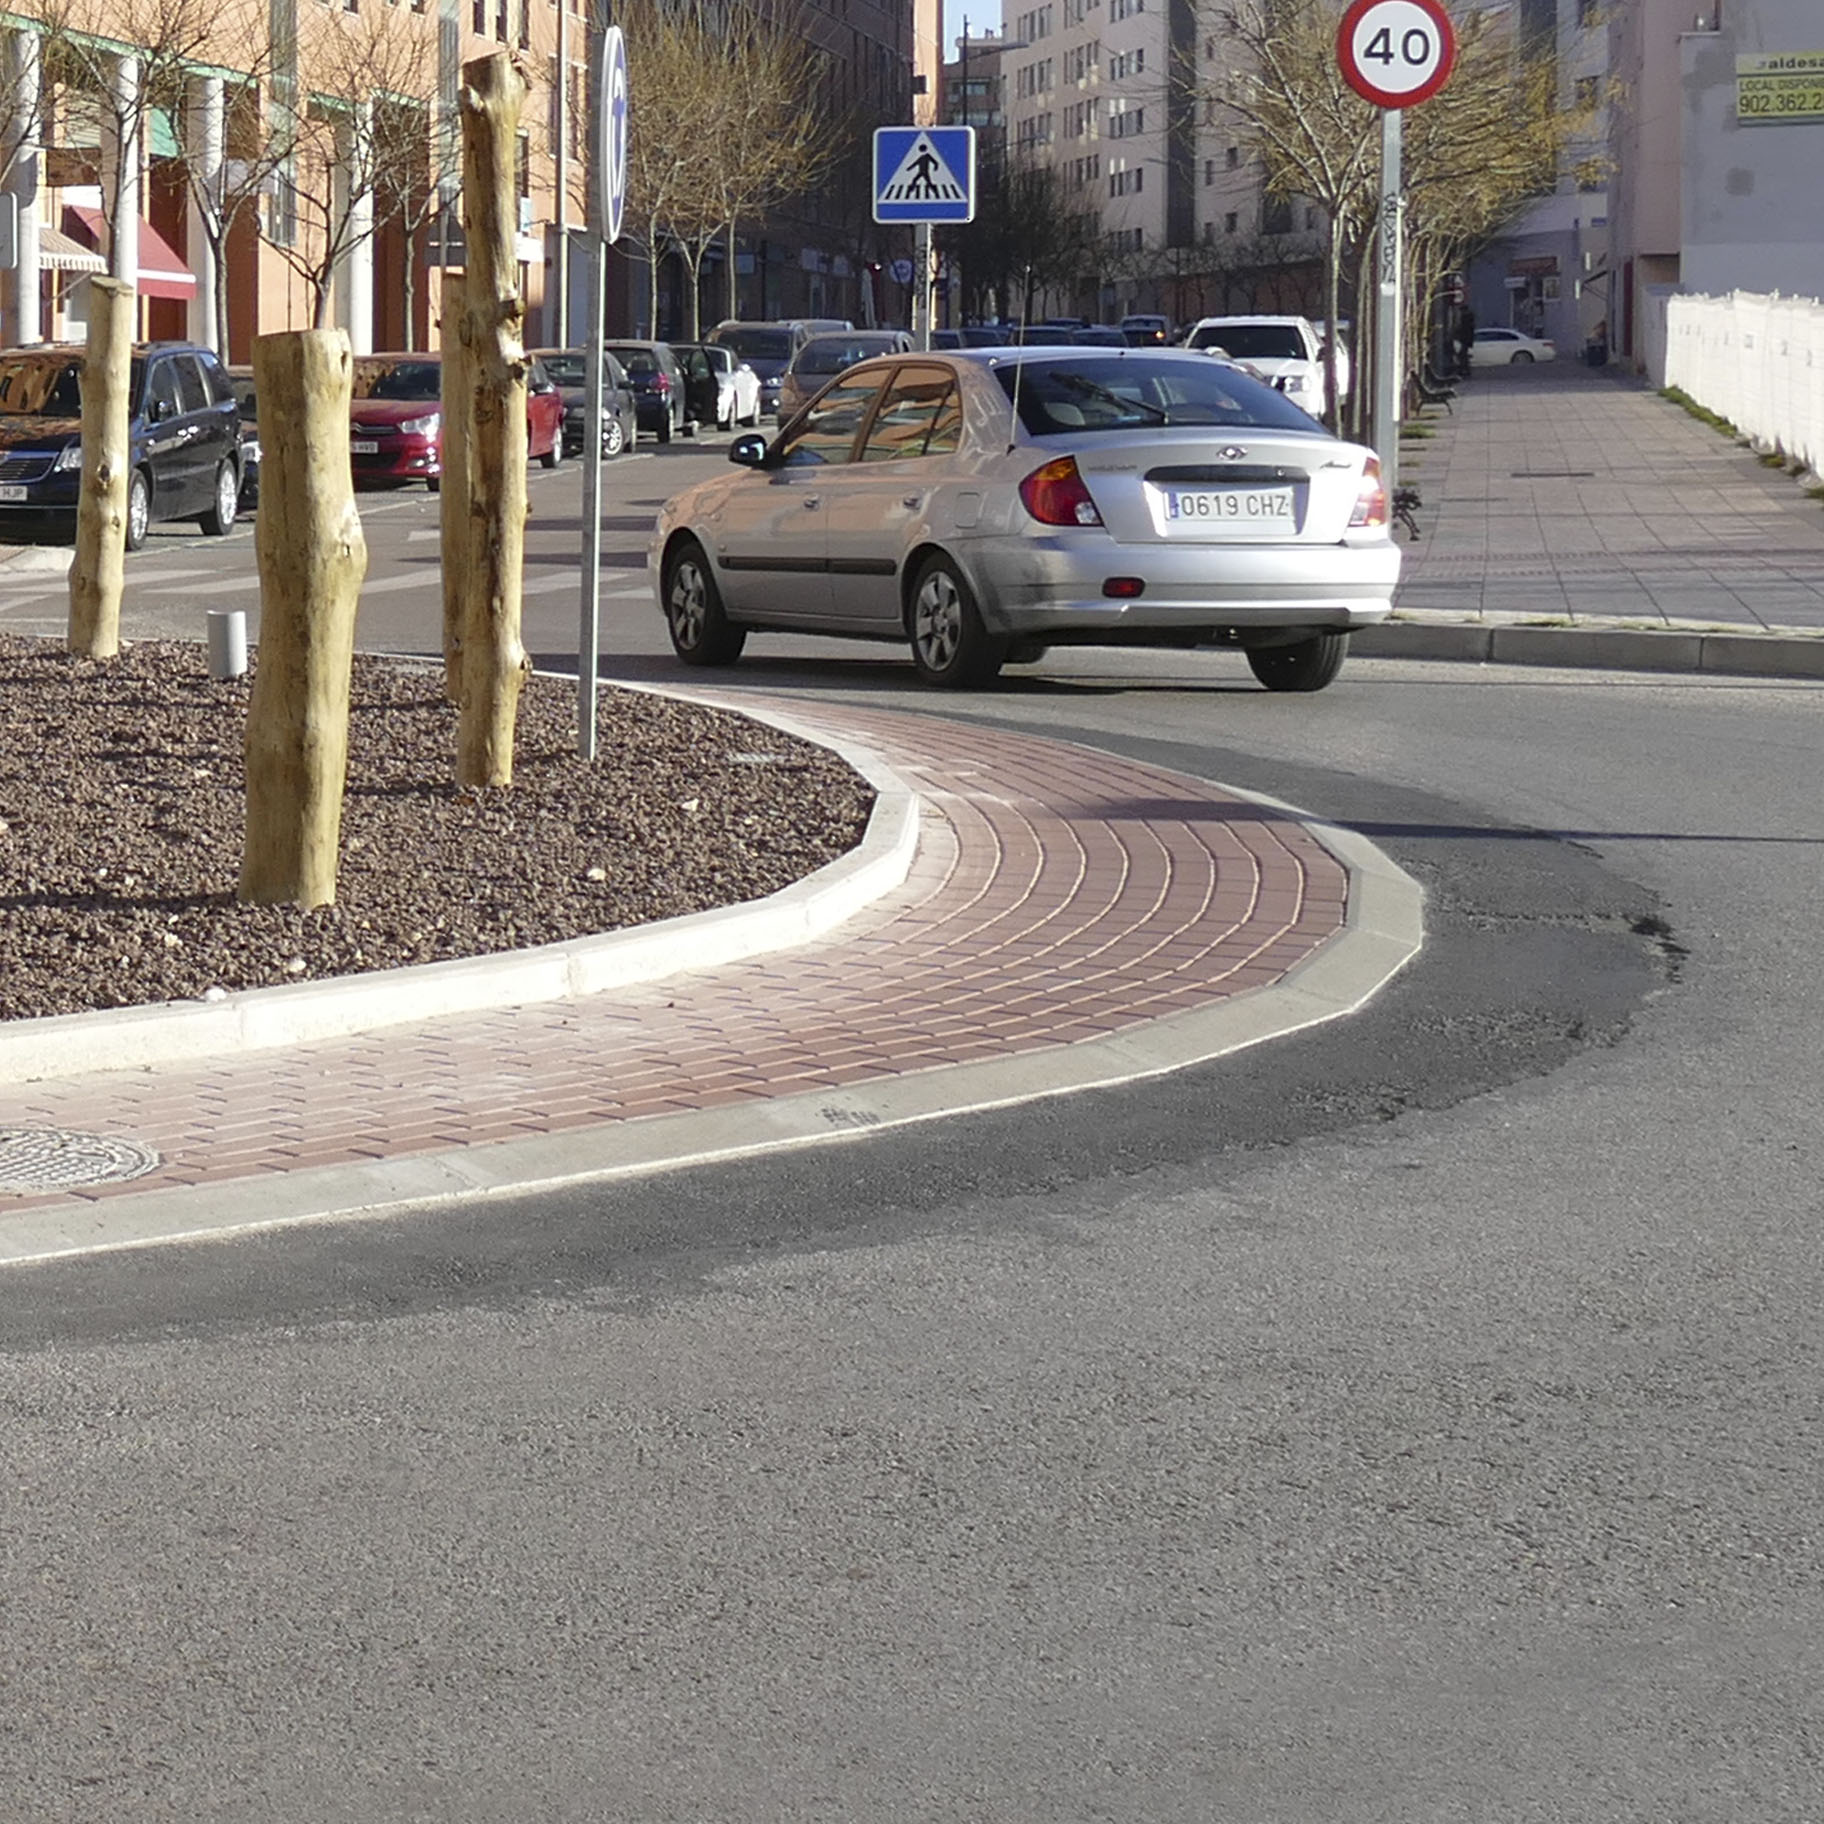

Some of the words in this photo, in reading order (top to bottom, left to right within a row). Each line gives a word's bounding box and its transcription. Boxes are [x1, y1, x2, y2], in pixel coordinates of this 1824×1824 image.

[1363, 28, 1430, 66] 40
[1739, 92, 1824, 113] 902.362.2
[1181, 494, 1239, 516] 0619
[1246, 493, 1288, 516] CHZ
